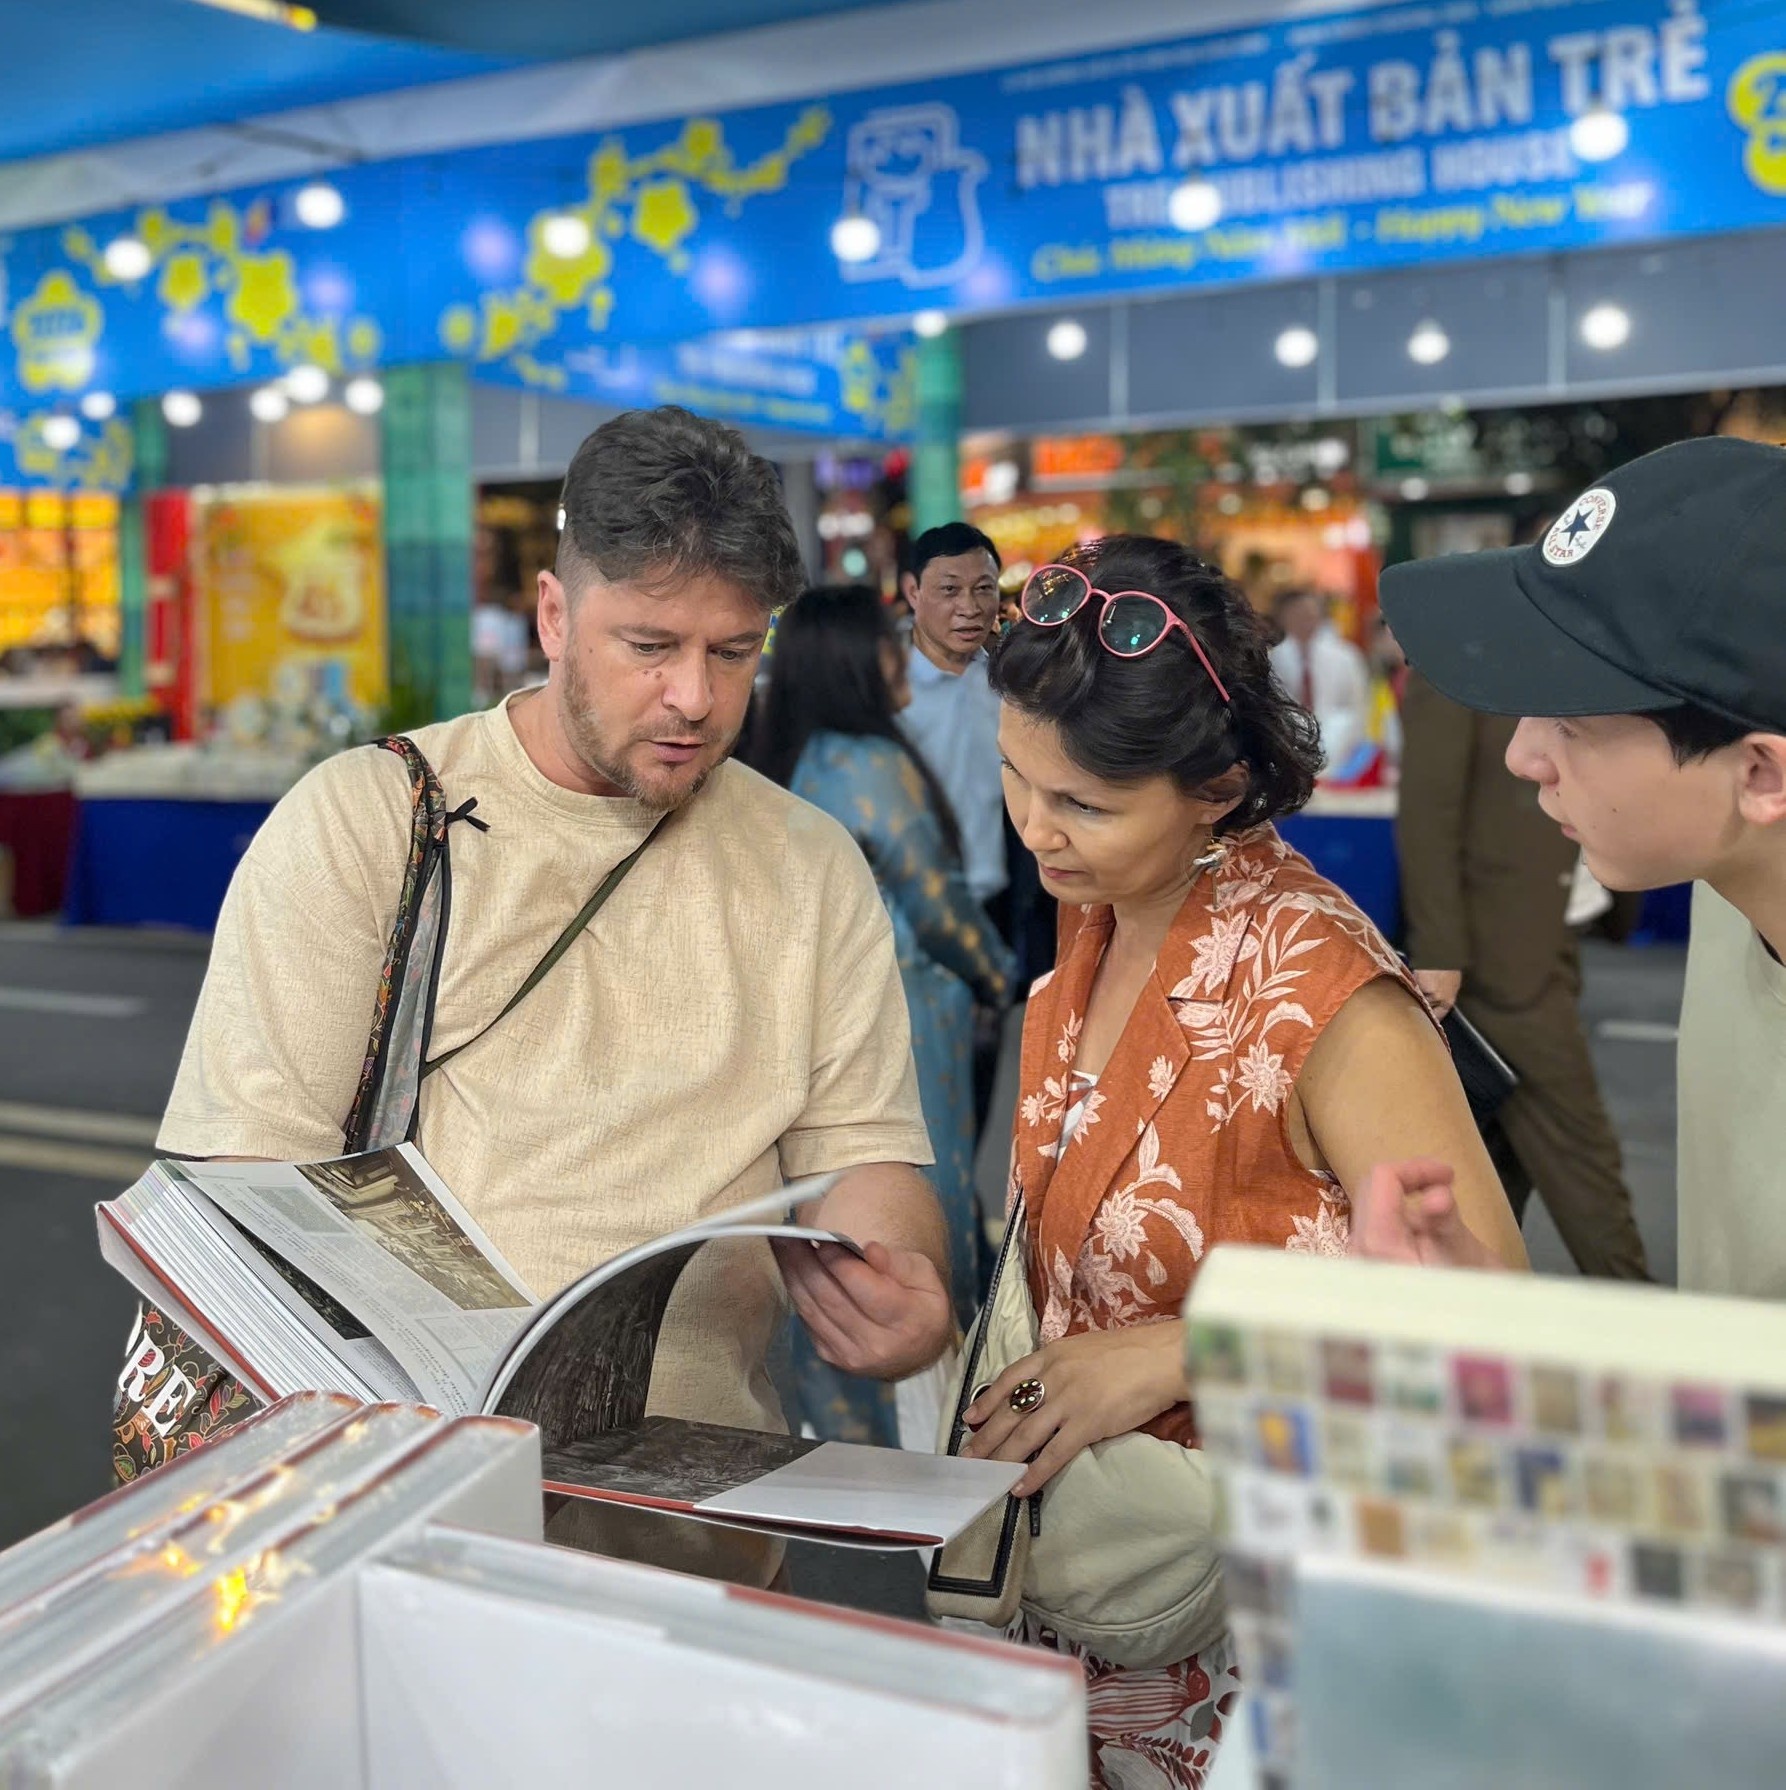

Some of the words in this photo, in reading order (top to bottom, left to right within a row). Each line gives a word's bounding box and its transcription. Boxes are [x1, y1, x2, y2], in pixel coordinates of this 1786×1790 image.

[1015, 84, 1163, 189] NHÀ
[1170, 50, 1355, 168] XUẤT
[1368, 30, 1534, 142] BẢN
[1548, 0, 1710, 120] TRẺ
[1549, 545, 1574, 557] STAR
[118, 1300, 197, 1437] RE
